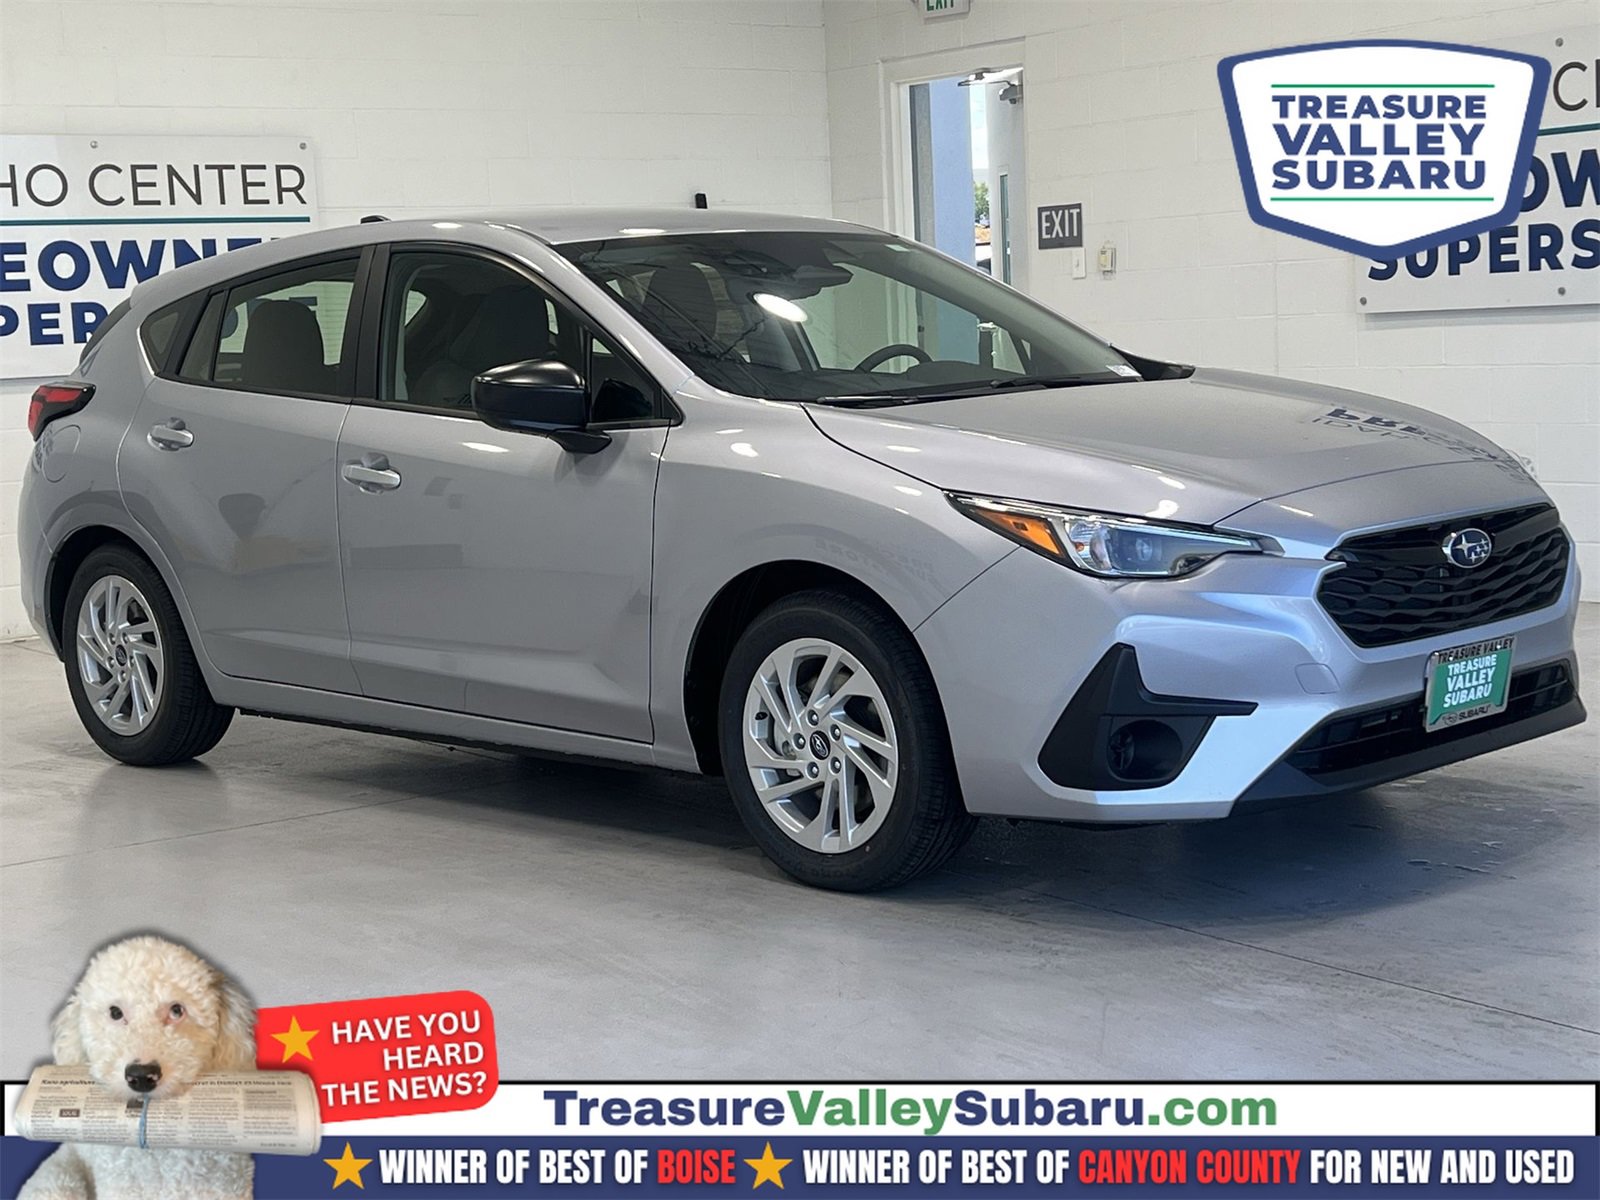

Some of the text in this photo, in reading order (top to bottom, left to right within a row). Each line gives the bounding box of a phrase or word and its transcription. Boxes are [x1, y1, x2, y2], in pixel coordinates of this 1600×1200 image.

[1553, 58, 1600, 112] C
[88, 164, 307, 206] CENTER
[1041, 208, 1080, 240] EXIT
[0, 238, 280, 292] EOW
[1437, 637, 1514, 664] TREASURE VALLEY
[1447, 654, 1497, 676] TREASURE
[1446, 667, 1496, 692] VALLEY
[1443, 683, 1492, 708] SUBARU
[1458, 704, 1491, 720] SUBARU
